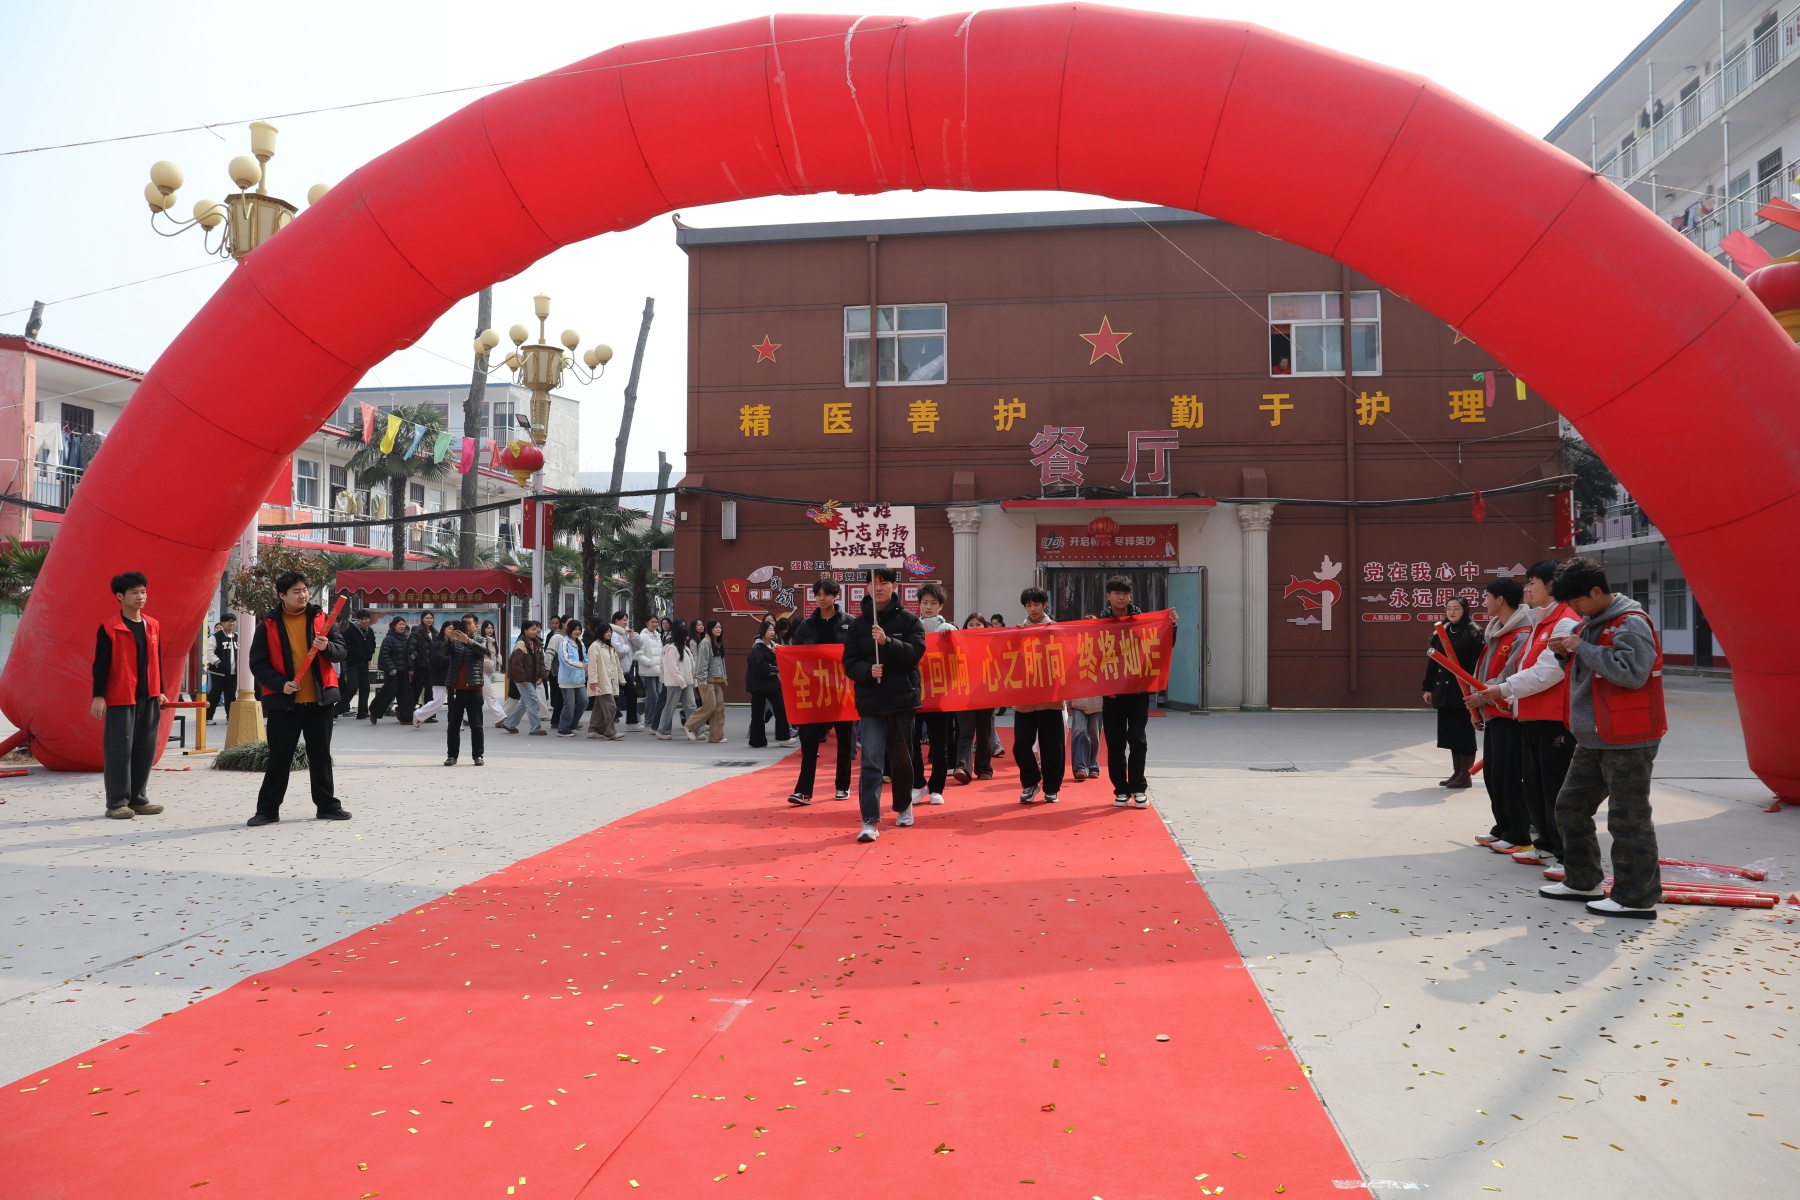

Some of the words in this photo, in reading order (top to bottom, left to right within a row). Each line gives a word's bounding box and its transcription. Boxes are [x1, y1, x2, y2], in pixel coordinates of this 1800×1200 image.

[739, 398, 1027, 437] 精医善护
[1171, 389, 1486, 429] 勤于护理
[1029, 424, 1180, 488] 餐厅
[837, 520, 909, 542] 斗志昂扬
[830, 541, 907, 560] 六班最强
[1363, 561, 1480, 582] 党在我心中
[1389, 587, 1488, 608] 永远跟党
[792, 658, 857, 711] 全力以
[920, 645, 970, 699] 回响
[982, 635, 1066, 692] 心之所向
[1077, 626, 1161, 682] 终将灿烂
